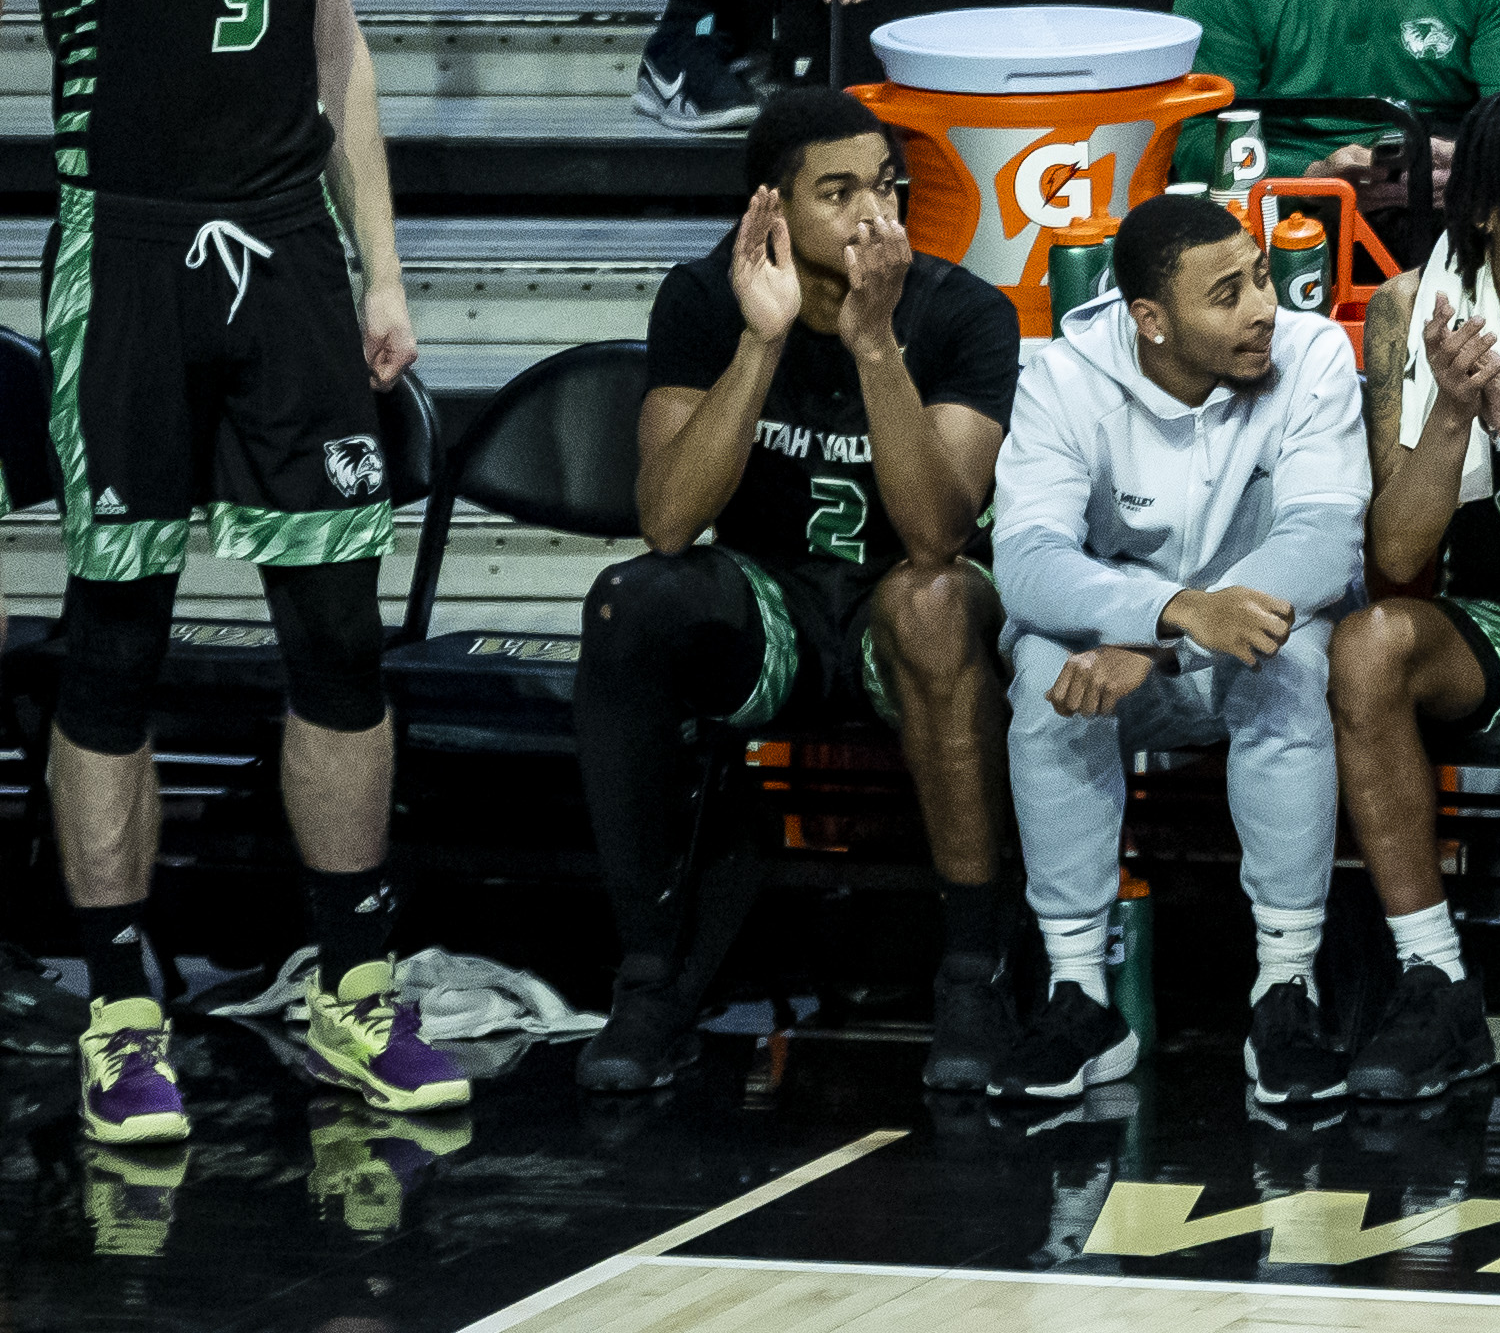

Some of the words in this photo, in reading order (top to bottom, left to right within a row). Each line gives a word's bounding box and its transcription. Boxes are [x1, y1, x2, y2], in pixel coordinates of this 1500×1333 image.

[1015, 141, 1092, 229] G
[1289, 269, 1322, 310] G
[816, 433, 872, 464] VALL
[806, 477, 867, 564] 2
